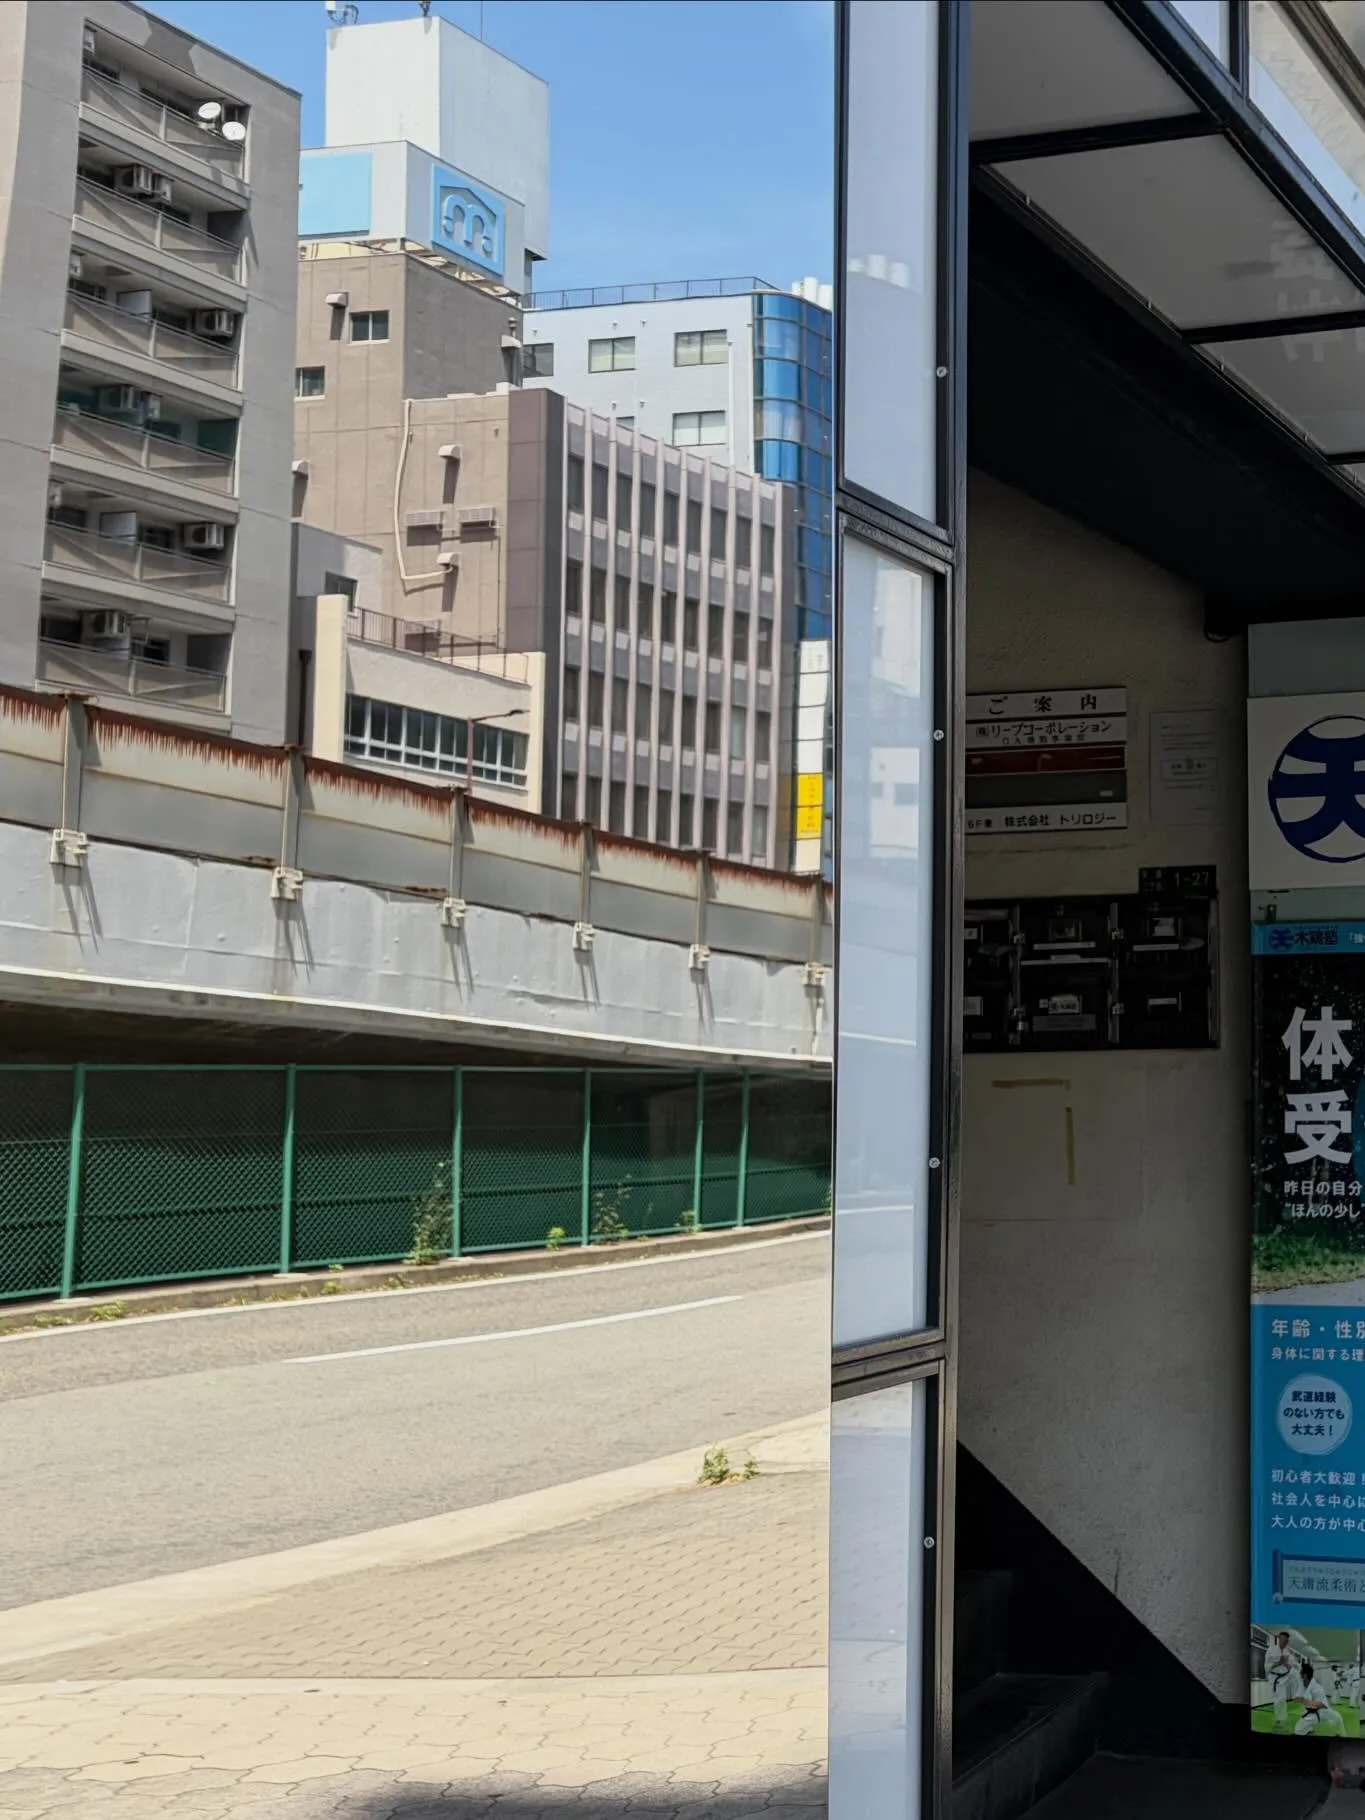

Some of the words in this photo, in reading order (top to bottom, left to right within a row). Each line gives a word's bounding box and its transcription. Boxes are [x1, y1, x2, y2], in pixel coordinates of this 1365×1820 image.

[989, 693, 1097, 715] ご案内
[1005, 814, 1049, 828] 株式会社
[1060, 812, 1116, 826] トリロジー
[1292, 1390, 1336, 1403] 武道経験
[1283, 1407, 1345, 1420] のない方でも
